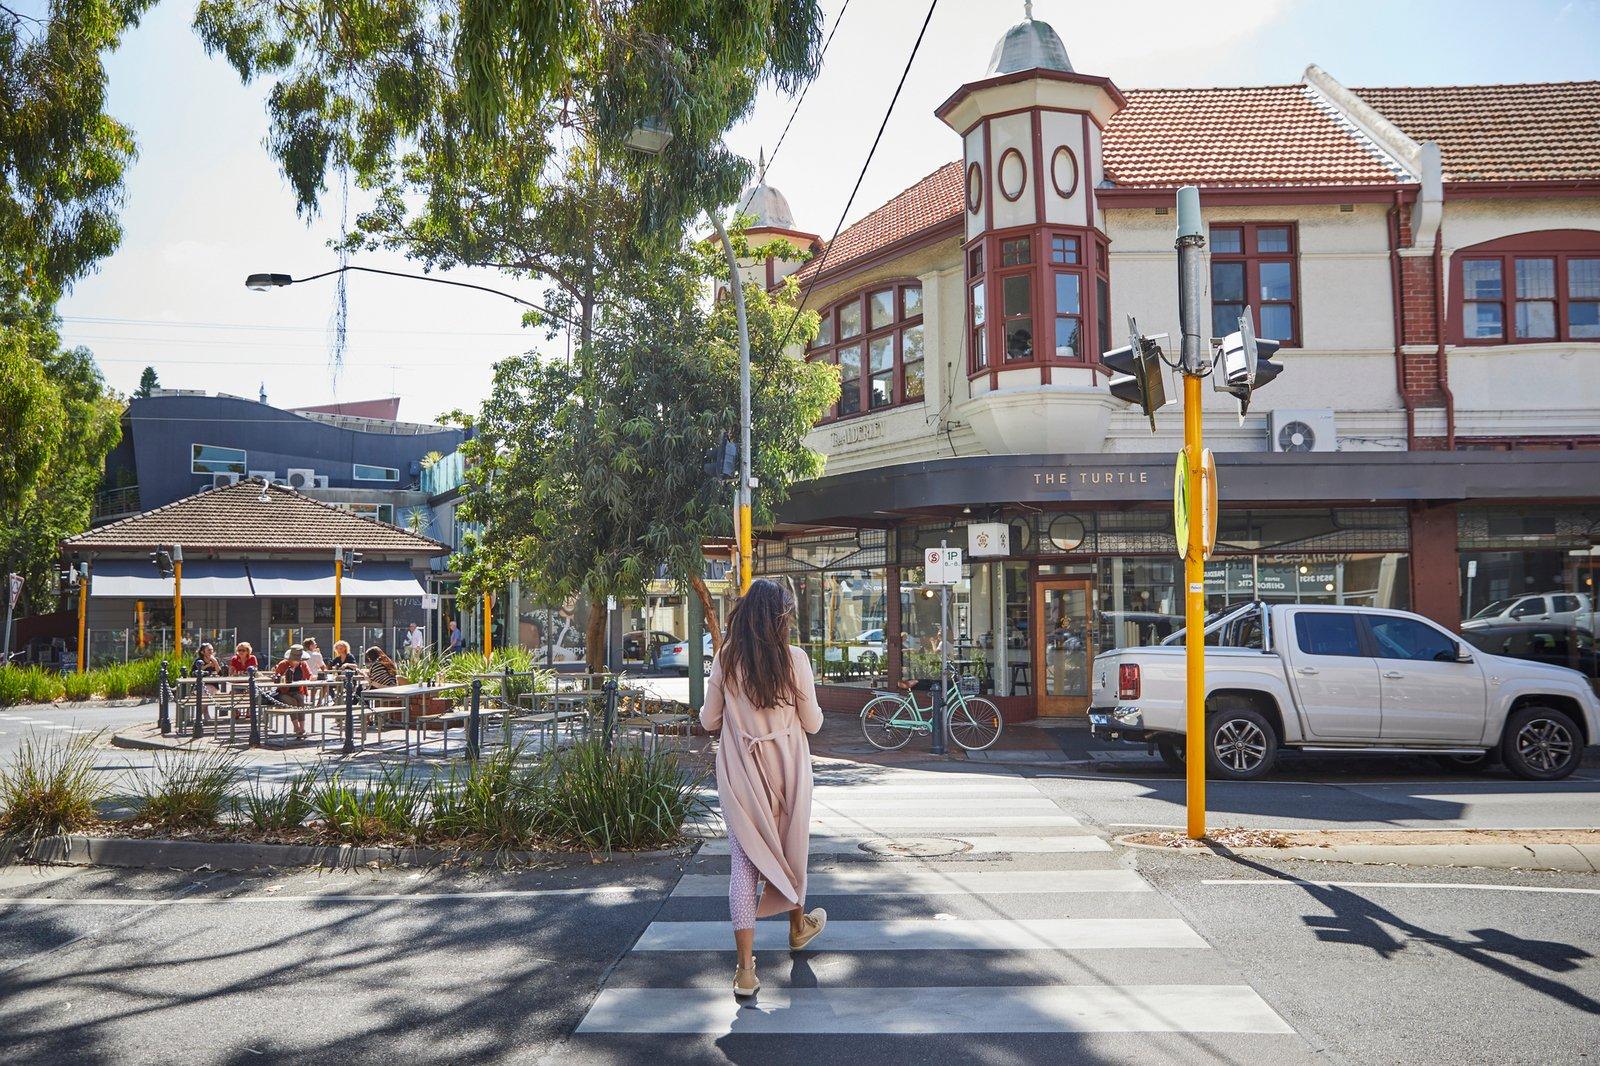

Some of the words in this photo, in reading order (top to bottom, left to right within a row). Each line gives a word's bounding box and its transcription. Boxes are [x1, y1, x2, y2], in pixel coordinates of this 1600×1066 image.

[1034, 472, 1068, 485] THE
[1080, 472, 1148, 484] TURTLE
[947, 551, 958, 561] 1P
